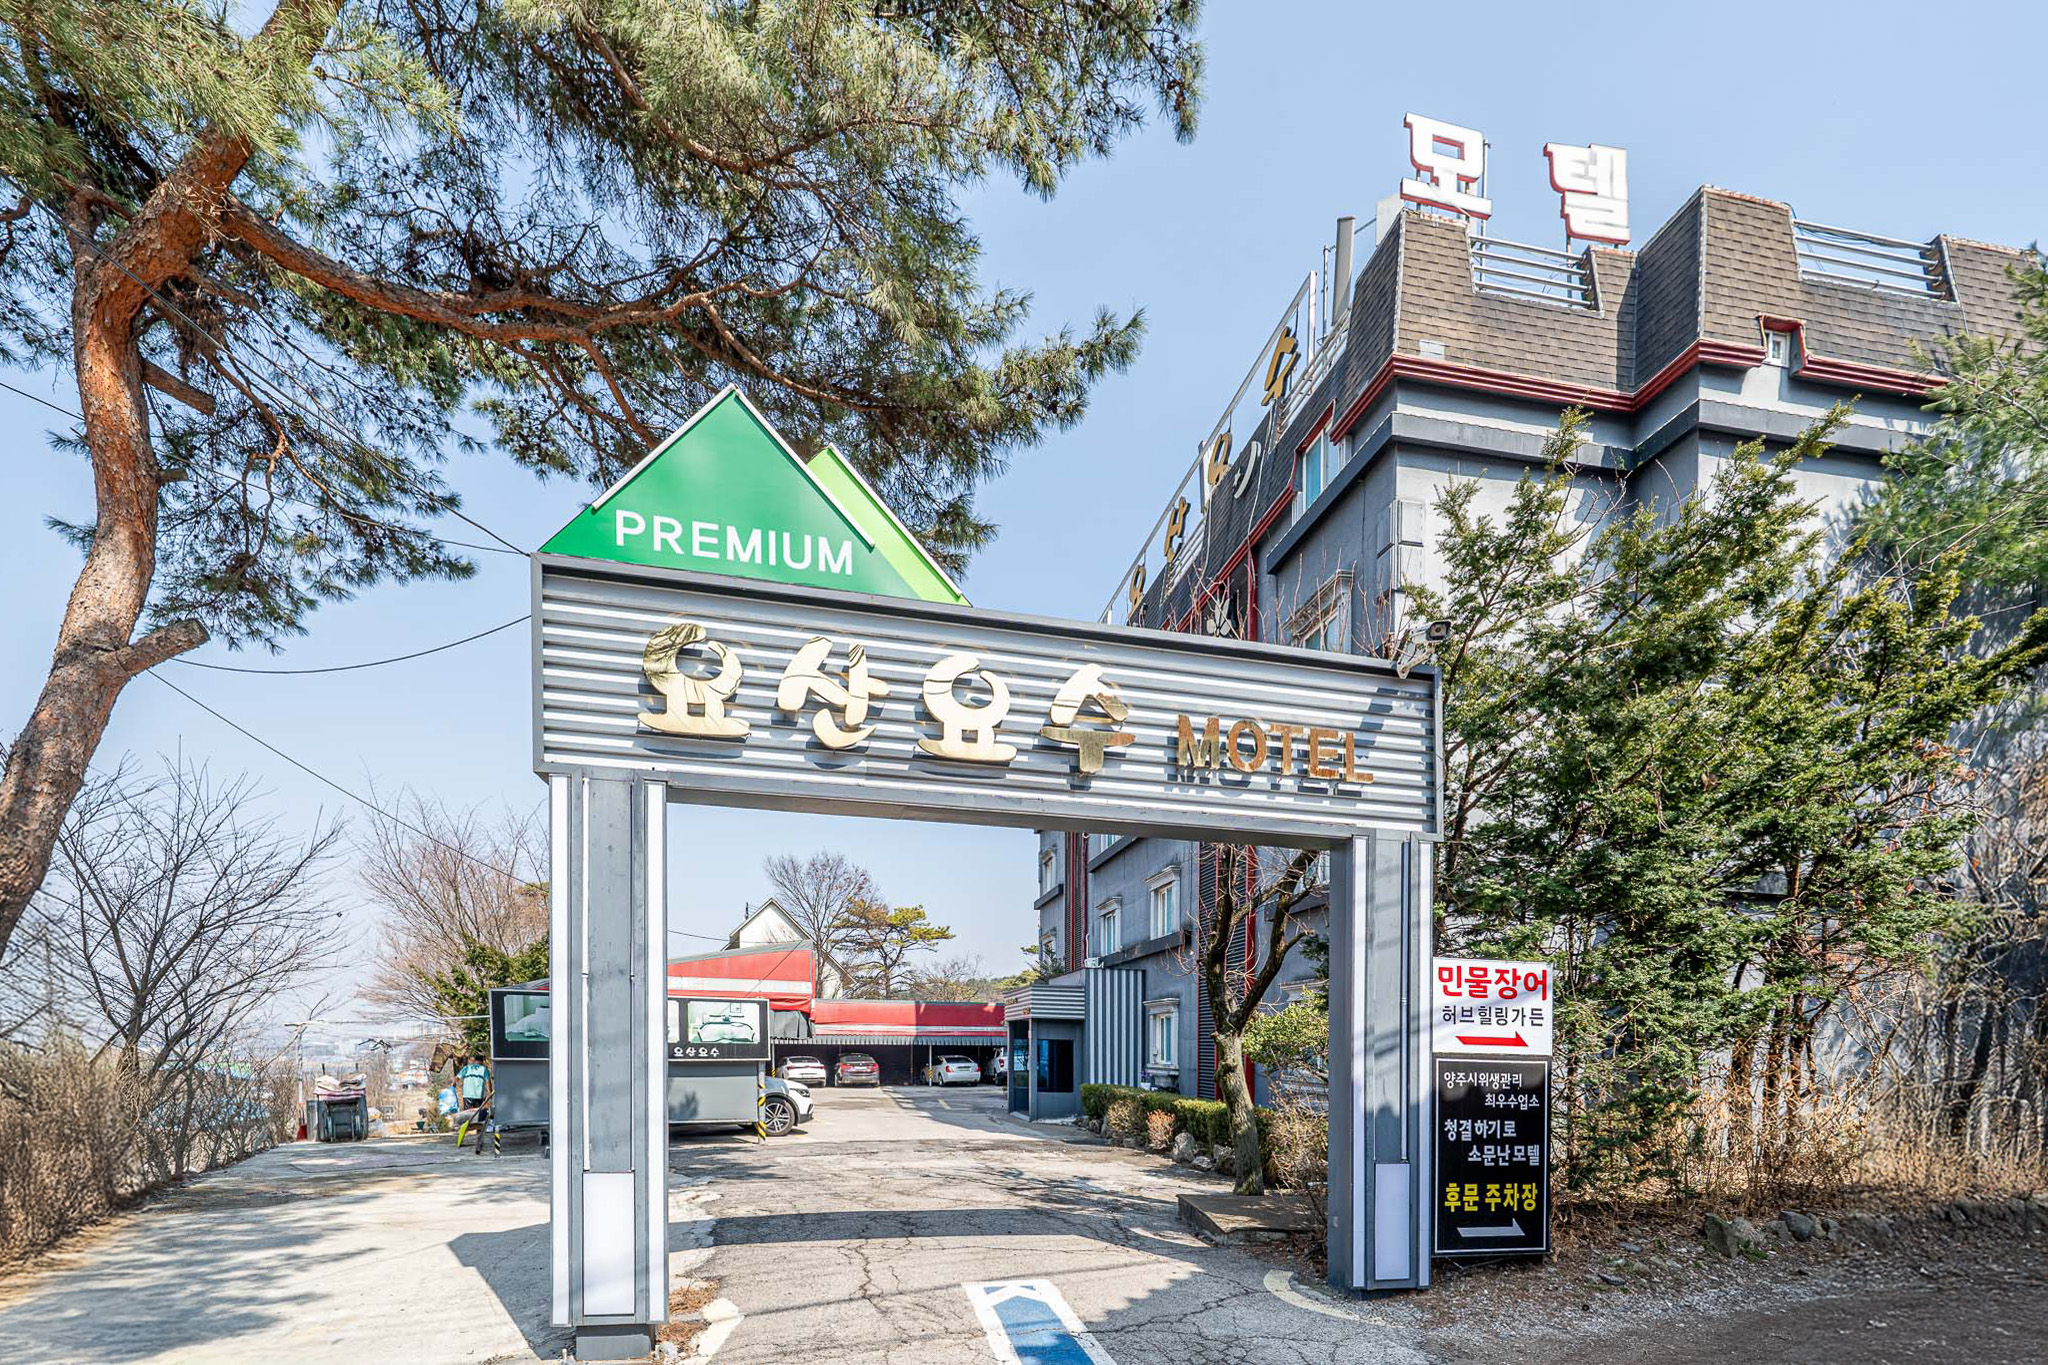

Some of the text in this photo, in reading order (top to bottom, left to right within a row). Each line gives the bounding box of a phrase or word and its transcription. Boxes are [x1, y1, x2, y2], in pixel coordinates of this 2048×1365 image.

[1400, 112, 1631, 245] 모텔
[615, 509, 853, 576] PREMIUM
[1176, 713, 1374, 783] MOTEL
[1438, 965, 1547, 1001] 민물장어
[1443, 1071, 1522, 1090] 양주시위생관리
[1484, 1093, 1540, 1110] 최우수업소
[1444, 1118, 1517, 1141] 청결하기로
[1444, 1182, 1538, 1212] 후문 주차장
